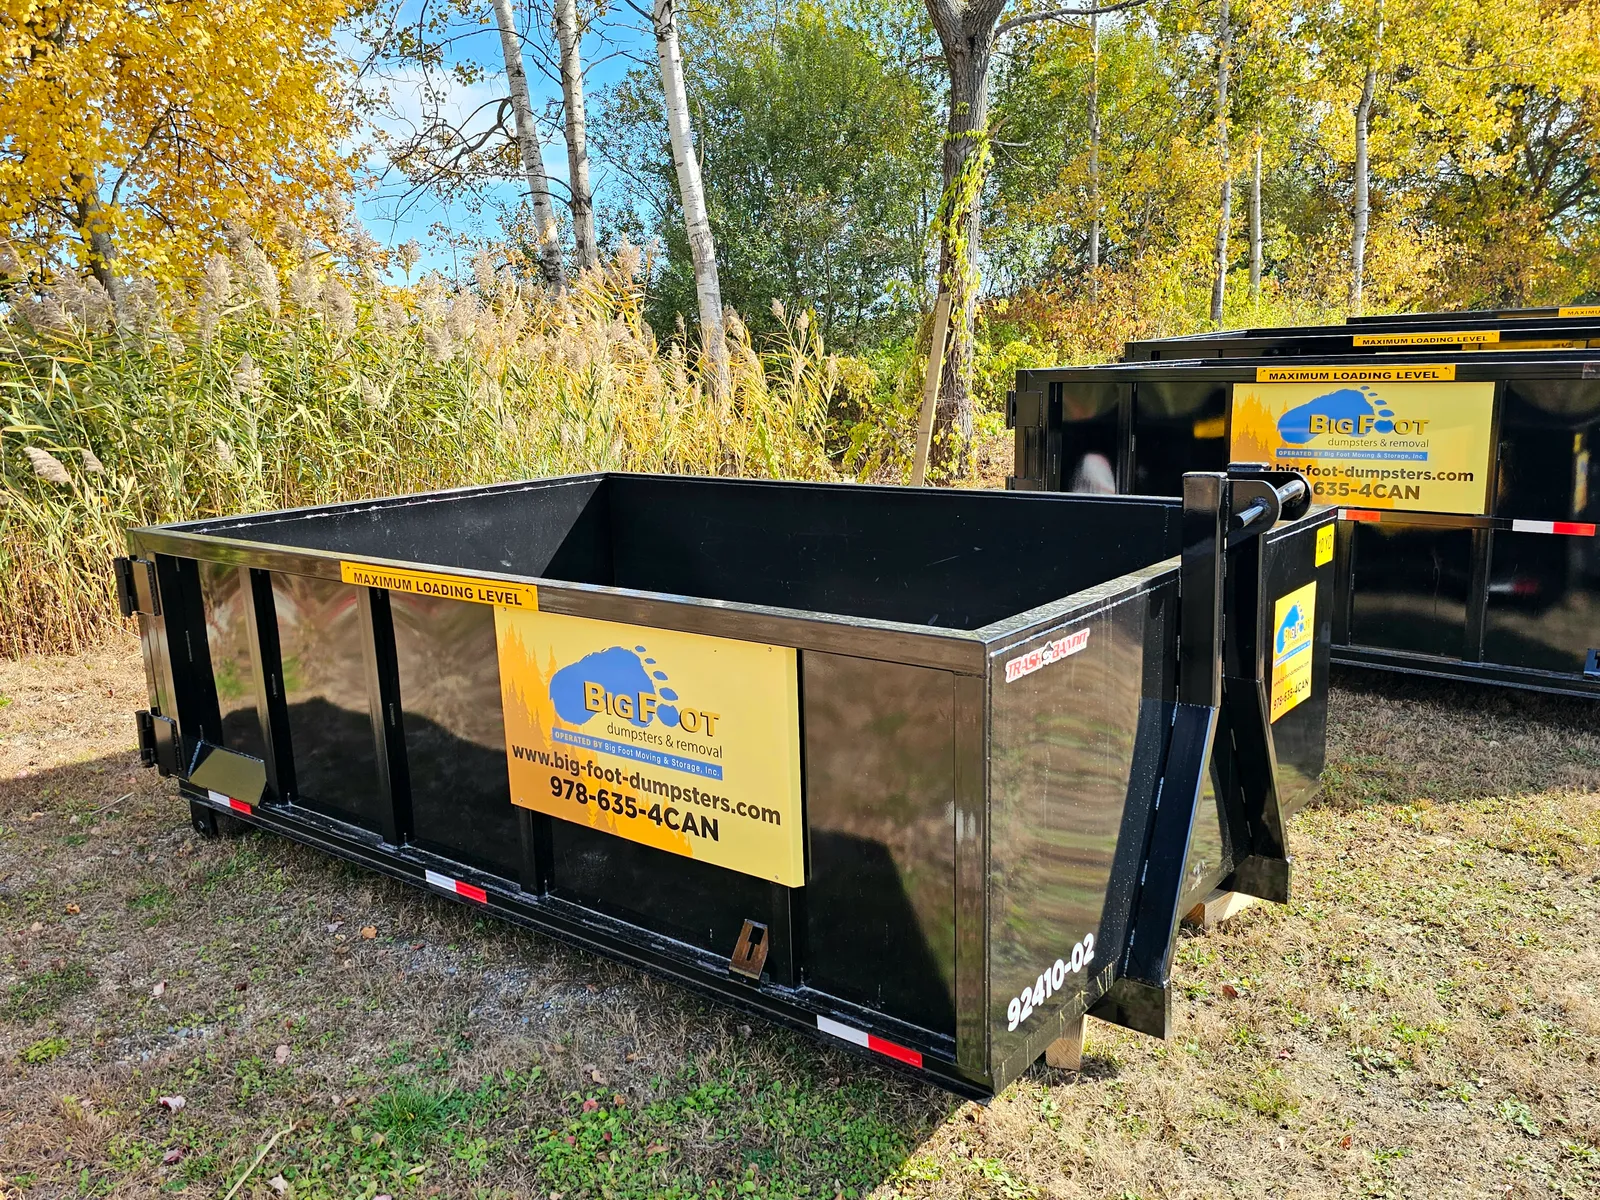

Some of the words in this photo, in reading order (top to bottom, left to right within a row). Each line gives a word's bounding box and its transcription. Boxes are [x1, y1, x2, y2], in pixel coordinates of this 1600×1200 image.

[1411, 336, 1454, 344] LOADING
[1269, 372, 1329, 380] MAXIMUM
[1333, 371, 1392, 380] LOADING
[1396, 371, 1439, 379] LEVEL
[1324, 451, 1335, 459] Big
[1352, 452, 1375, 460] Moving
[1383, 452, 1411, 460] Storage,
[1328, 438, 1377, 449] dumpsters
[1380, 439, 1388, 447] &
[1389, 439, 1429, 448] removal
[1313, 481, 1420, 501] 635-4CAN
[353, 572, 412, 591] MAXIMUM
[415, 581, 474, 599] LOADING
[478, 589, 522, 606] LEVEL
[554, 731, 592, 746] OPERATED
[593, 739, 603, 749] BY
[604, 742, 616, 753] Big
[617, 745, 634, 757] Foot
[635, 749, 661, 765] Moving
[663, 756, 669, 765] &
[671, 758, 703, 774] Storage,
[705, 765, 720, 777] Inc.
[606, 721, 663, 746] dumpsters
[665, 735, 674, 748] &
[676, 739, 723, 759] removal
[511, 744, 781, 826] www.big-foot-dumpsters.com
[550, 775, 719, 842] 978-635-4CAN
[1007, 932, 1095, 1032] 92410-02
